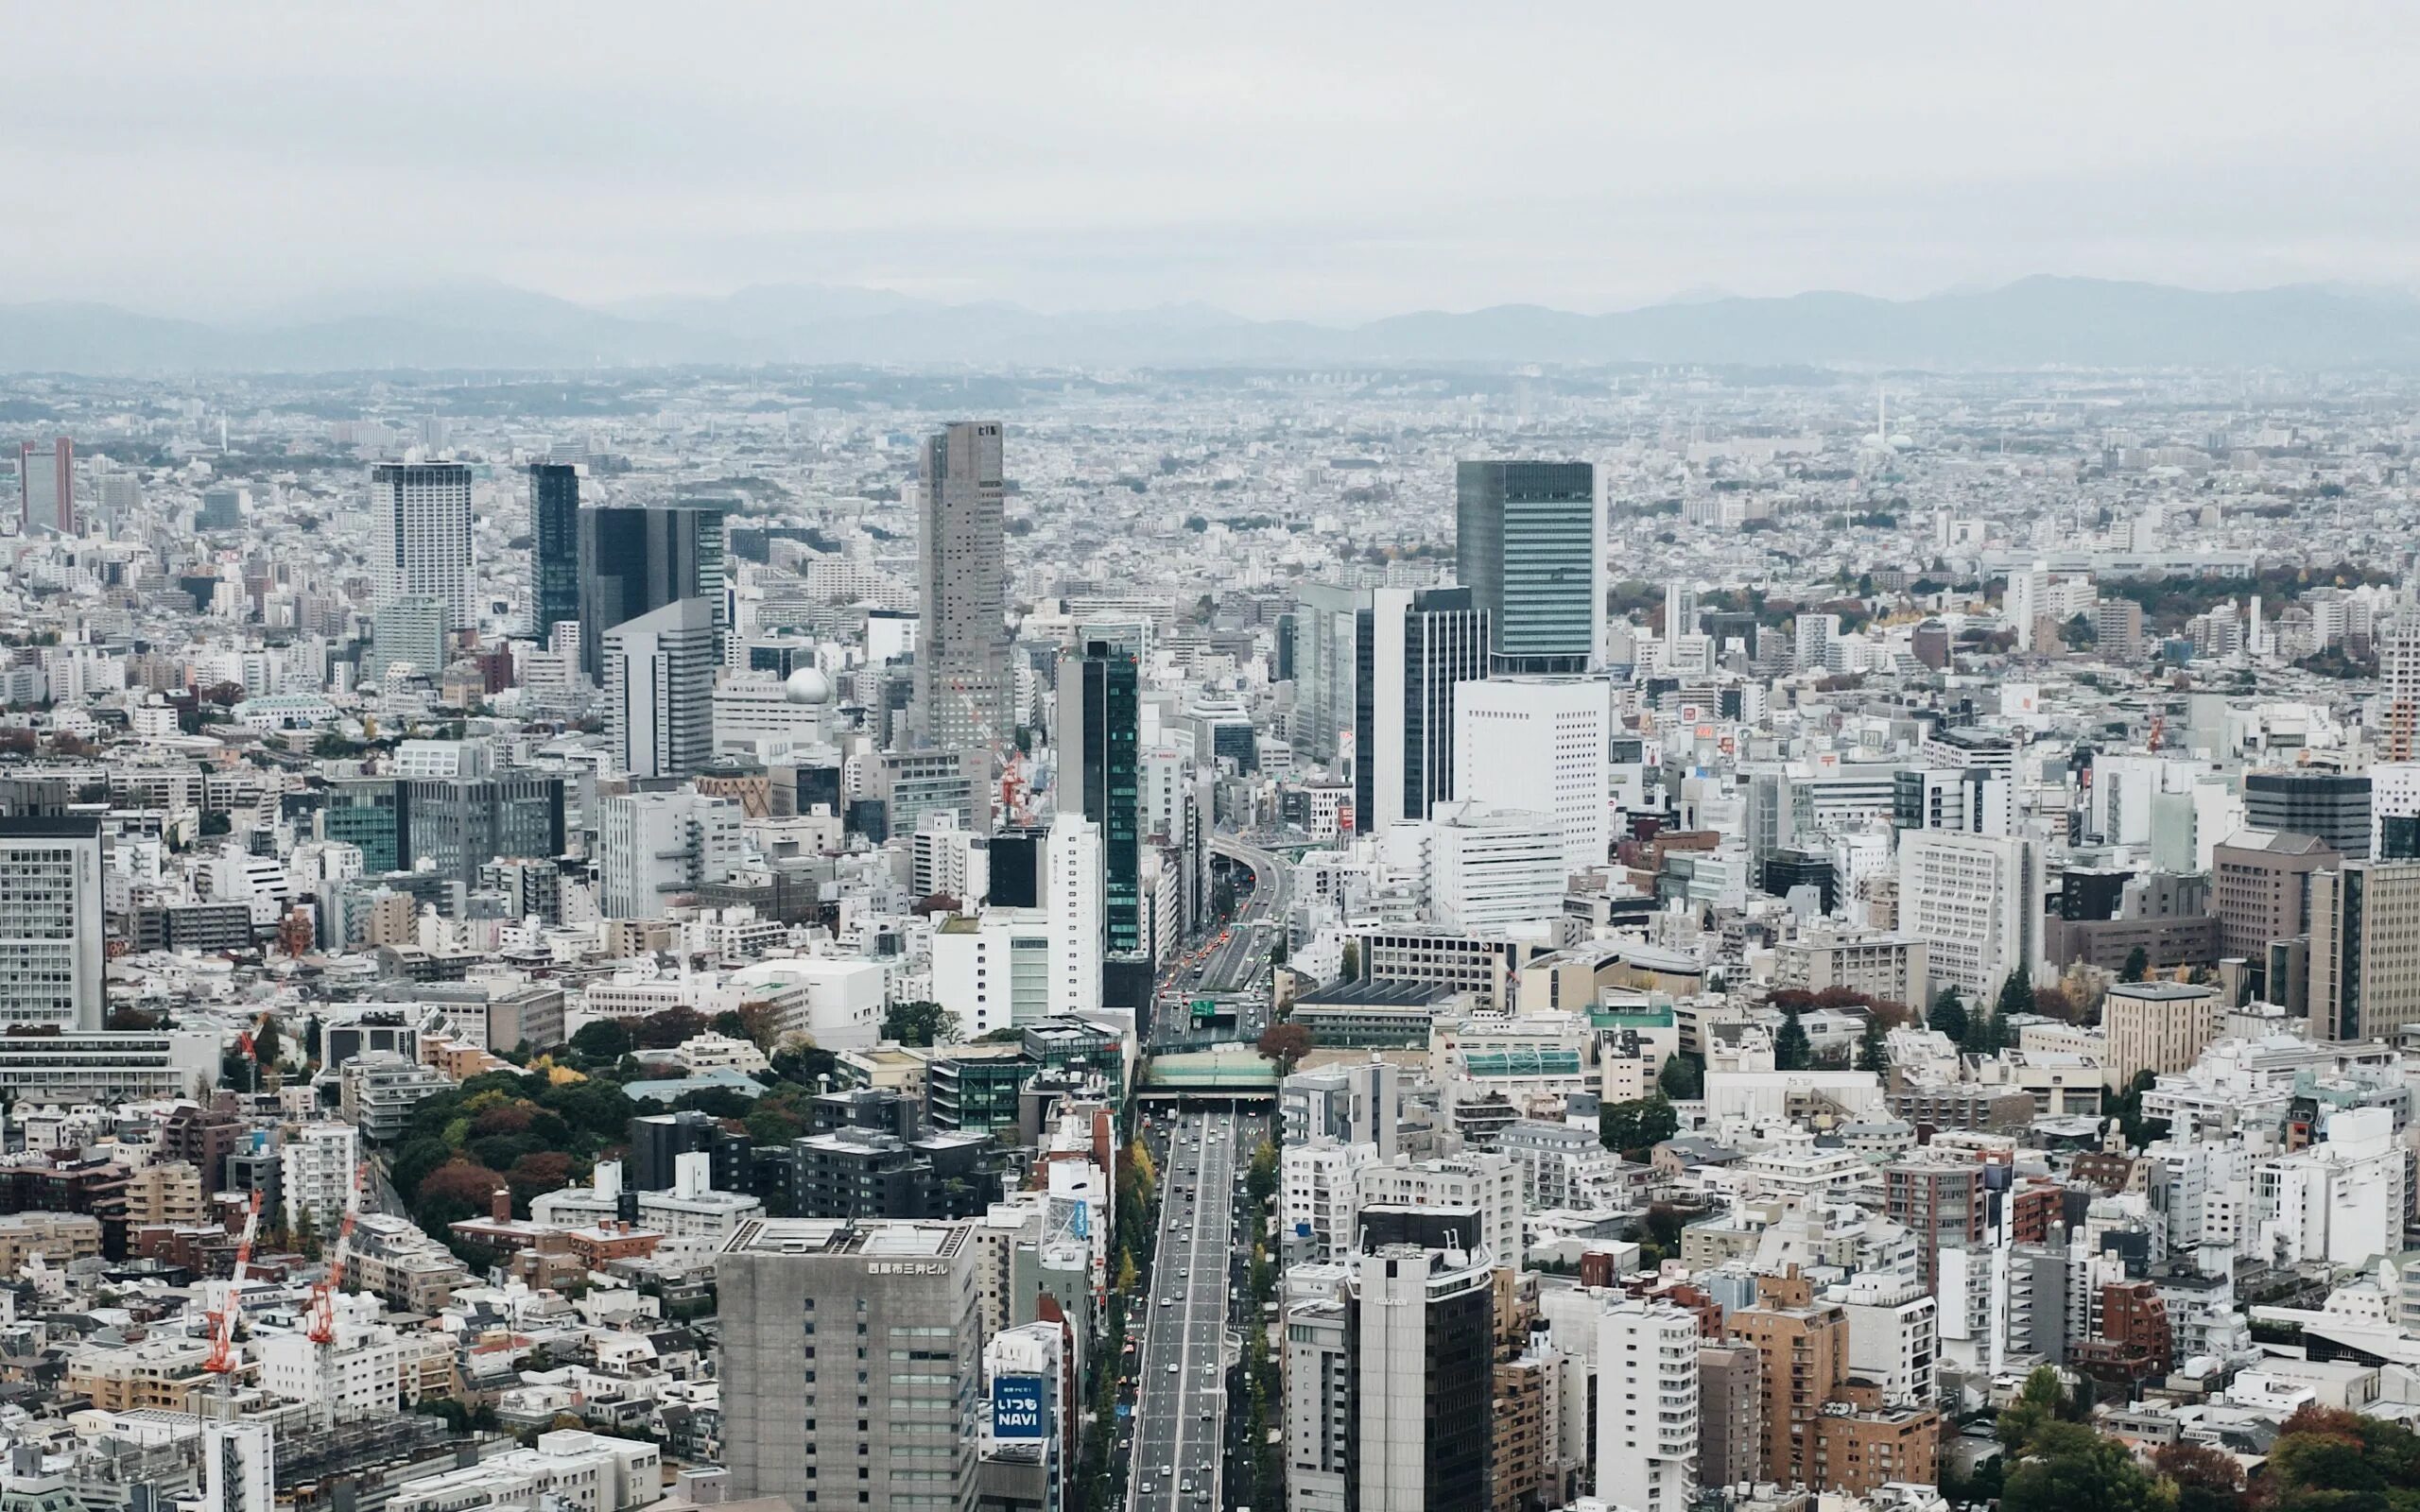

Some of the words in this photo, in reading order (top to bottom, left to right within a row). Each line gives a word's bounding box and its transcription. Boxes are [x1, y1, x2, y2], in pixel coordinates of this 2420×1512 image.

[868, 1263, 948, 1275] 西麻布三井ビル
[997, 1399, 1038, 1411] いつも
[998, 1413, 1037, 1426] NAVI
